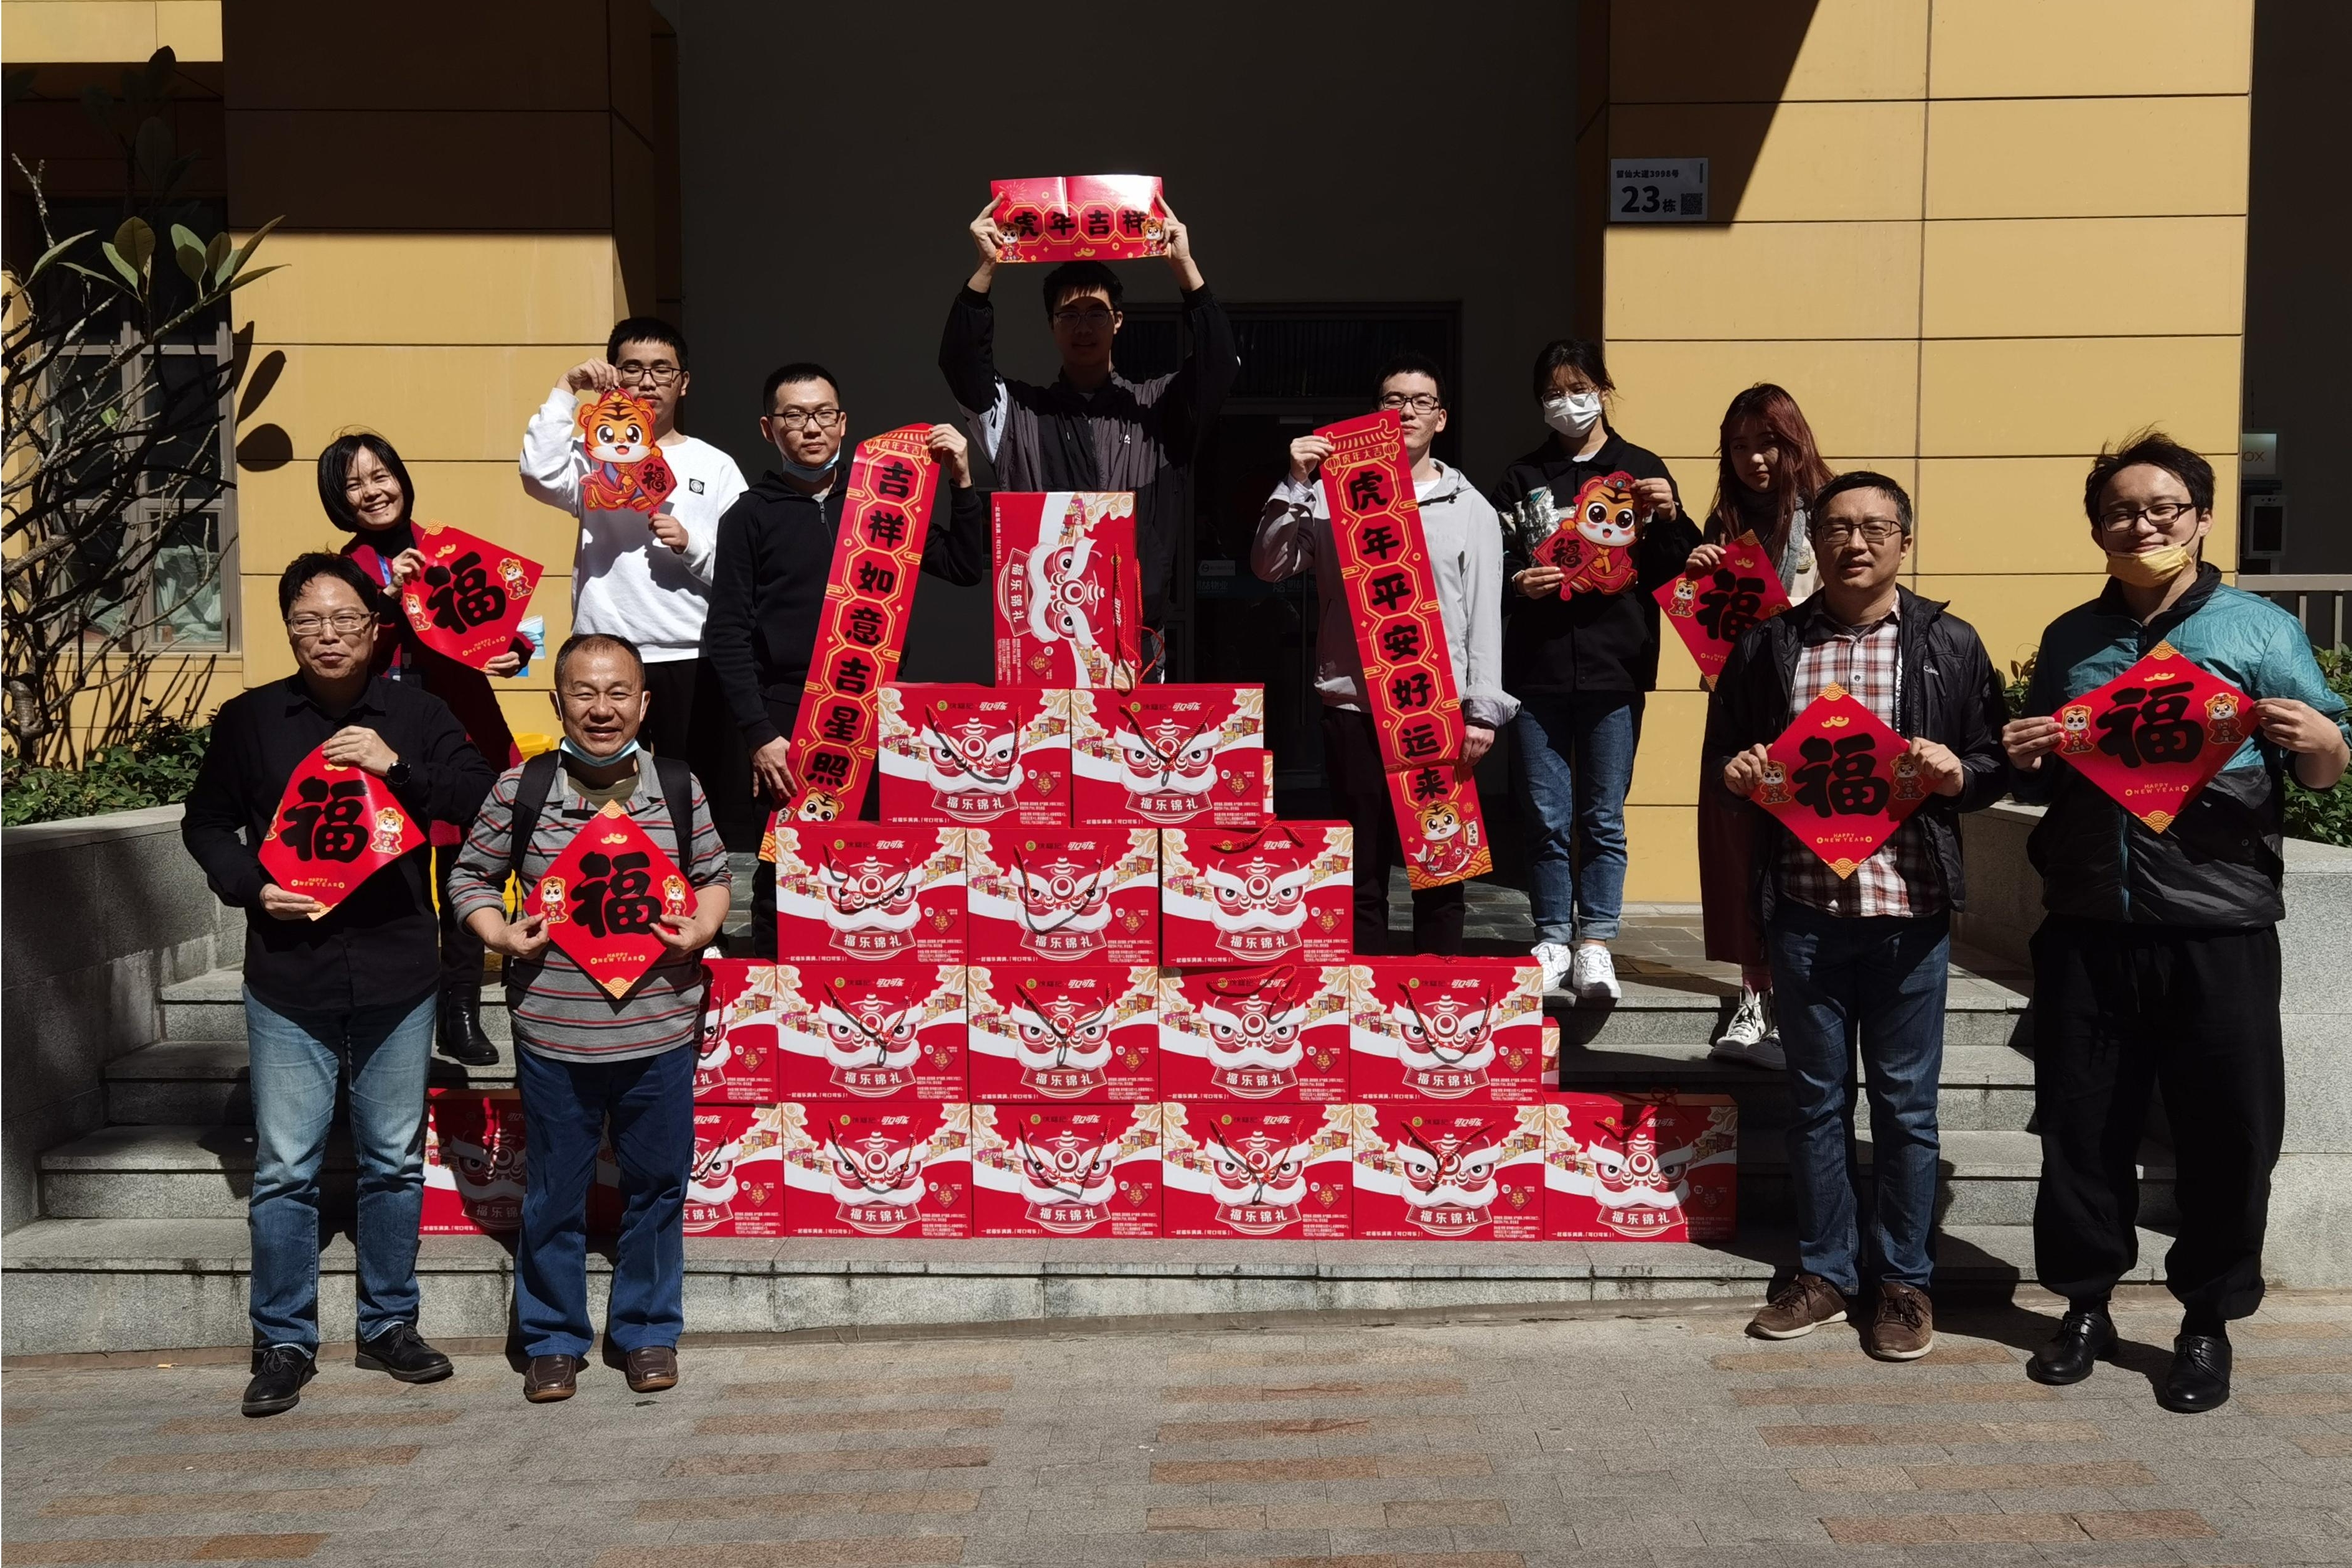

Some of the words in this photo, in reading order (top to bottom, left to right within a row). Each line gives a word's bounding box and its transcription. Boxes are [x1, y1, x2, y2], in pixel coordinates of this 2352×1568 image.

[1616, 169, 1679, 179] 留仙大道3998号
[1621, 185, 1677, 213] 23栋
[1014, 209, 1147, 236] 虎年吉祥
[881, 441, 920, 455] 虎年大吉
[1342, 446, 1381, 464] 虎年大吉
[642, 463, 666, 492] 福
[1551, 538, 1583, 569] 福
[424, 551, 506, 635] 福
[1010, 563, 1025, 623] 福乐锦礼
[1695, 567, 1766, 643] 福
[806, 462, 913, 788] 吉祥如意吉星照
[1350, 470, 1449, 801] 虎年平安好运来
[979, 701, 1009, 711] 可口可乐
[1172, 702, 1202, 712] 可口可乐
[2096, 681, 2204, 768] 福
[1791, 732, 1890, 818] 福
[946, 796, 1005, 810] 福乐锦礼
[1139, 796, 1198, 810] 福乐锦礼
[279, 776, 368, 863] 福
[875, 840, 905, 850] 可口可乐
[1067, 841, 1097, 851] 可口可乐
[1263, 840, 1293, 850] 可口可乐
[571, 851, 662, 938] 福
[843, 934, 902, 948] 福乐锦礼
[1034, 935, 1093, 948] 福乐锦礼
[1230, 935, 1289, 948] 福乐锦礼
[875, 978, 905, 987] 可口可乐
[1067, 979, 1097, 989] 可口可乐
[1451, 979, 1481, 989] 可口可乐
[844, 1071, 903, 1085] 福乐锦礼
[1035, 1072, 1094, 1086] 福乐锦礼
[1225, 1072, 1284, 1086] 福乐锦礼
[1417, 1072, 1476, 1086] 福乐锦礼
[693, 1114, 722, 1124] 可口可乐
[880, 1116, 910, 1126] 可口可乐
[1071, 1114, 1101, 1124] 可口可乐
[1262, 1115, 1292, 1125] 可口可乐
[1454, 1118, 1483, 1127] 可口可乐
[476, 1204, 519, 1218] 福乐锦
[849, 1208, 908, 1221] 福乐锦礼
[1038, 1207, 1098, 1221] 福乐锦礼
[1229, 1208, 1288, 1222] 福乐锦礼
[1419, 1210, 1478, 1223] 福乐锦礼
[1611, 1211, 1670, 1225] 福乐锦礼
